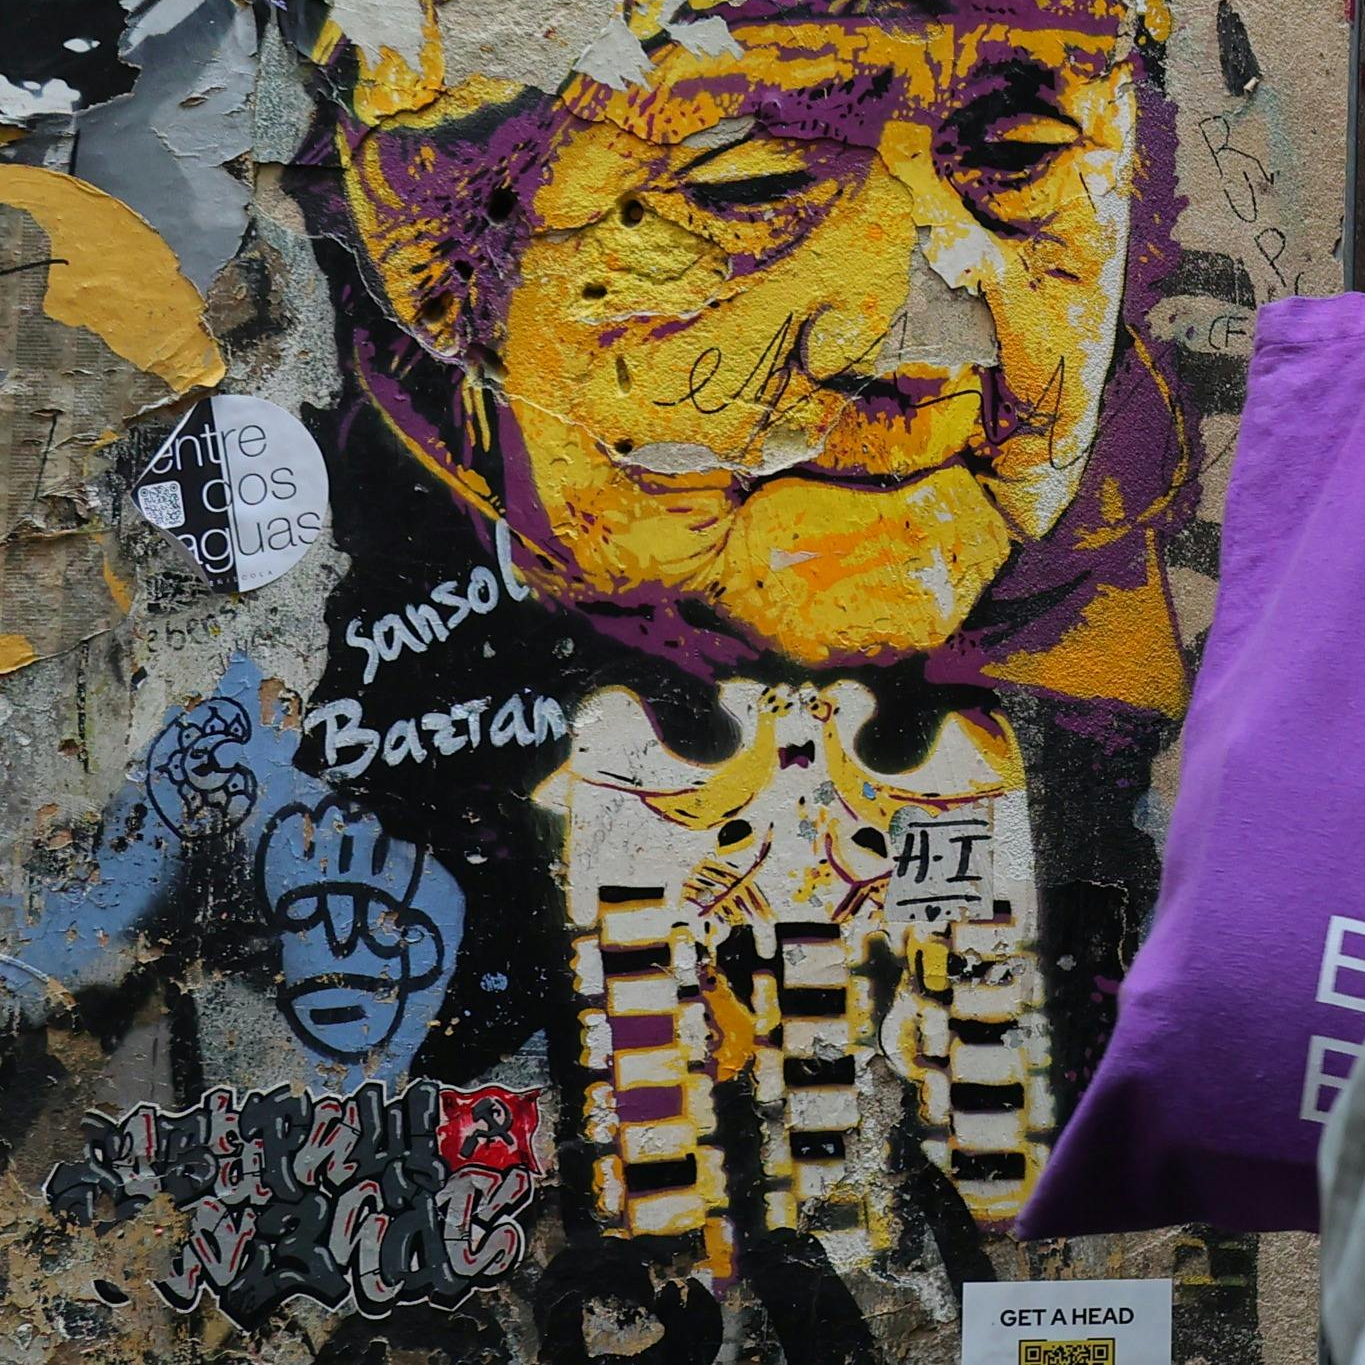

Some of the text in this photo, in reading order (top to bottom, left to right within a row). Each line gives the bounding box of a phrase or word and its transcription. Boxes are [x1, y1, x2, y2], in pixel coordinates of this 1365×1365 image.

[152, 418, 269, 475] entre
[200, 461, 299, 515] dos
[185, 505, 323, 571] aguas
[1000, 1307, 1135, 1327] GET A HEAD
